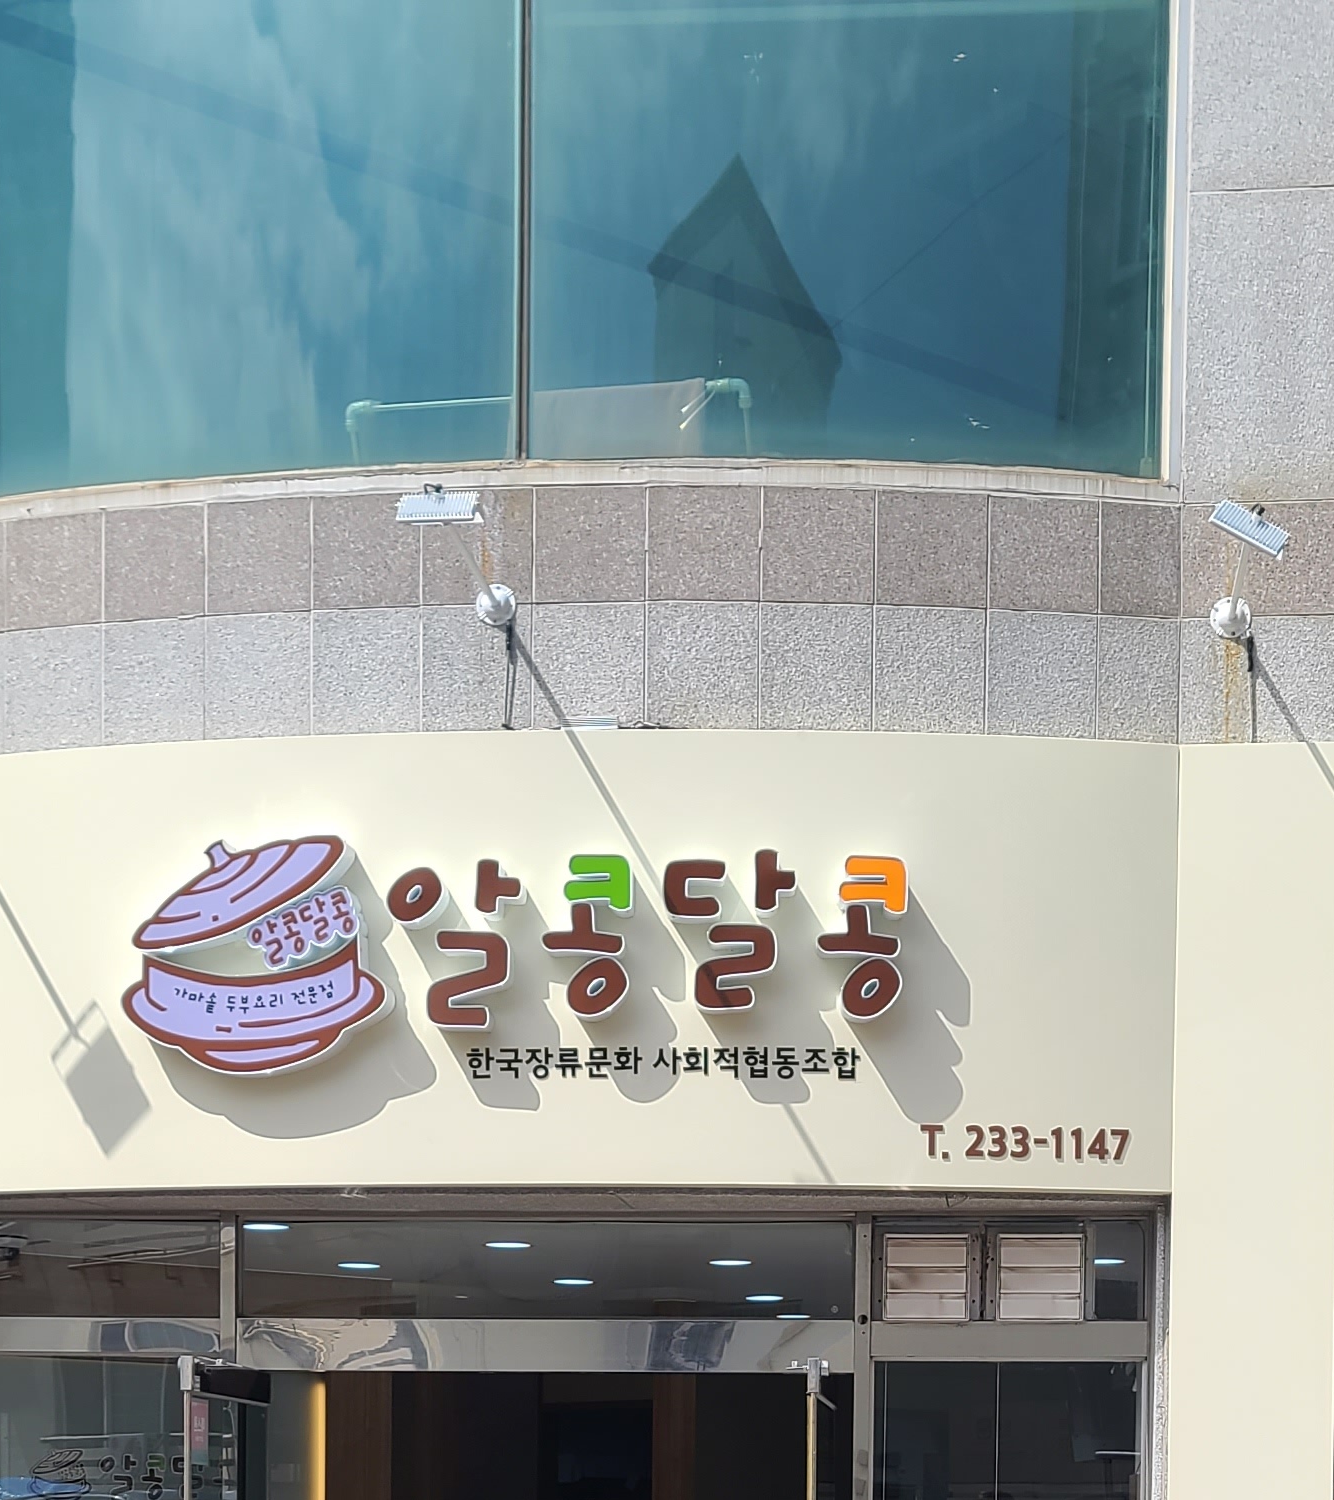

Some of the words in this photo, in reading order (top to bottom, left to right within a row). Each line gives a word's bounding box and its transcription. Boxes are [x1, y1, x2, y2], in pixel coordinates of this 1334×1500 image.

[249, 889, 356, 965] 알콩달콩
[386, 848, 908, 1032] 알콩달콩
[174, 987, 217, 1014] 가마솥
[225, 993, 284, 1015] 두부요리
[291, 980, 335, 1005] 전문점
[466, 1046, 643, 1080] 한국장류문화
[652, 1046, 861, 1081] 사회적협동조합
[920, 1124, 951, 1162] T.
[965, 1124, 1132, 1164] 233-1147
